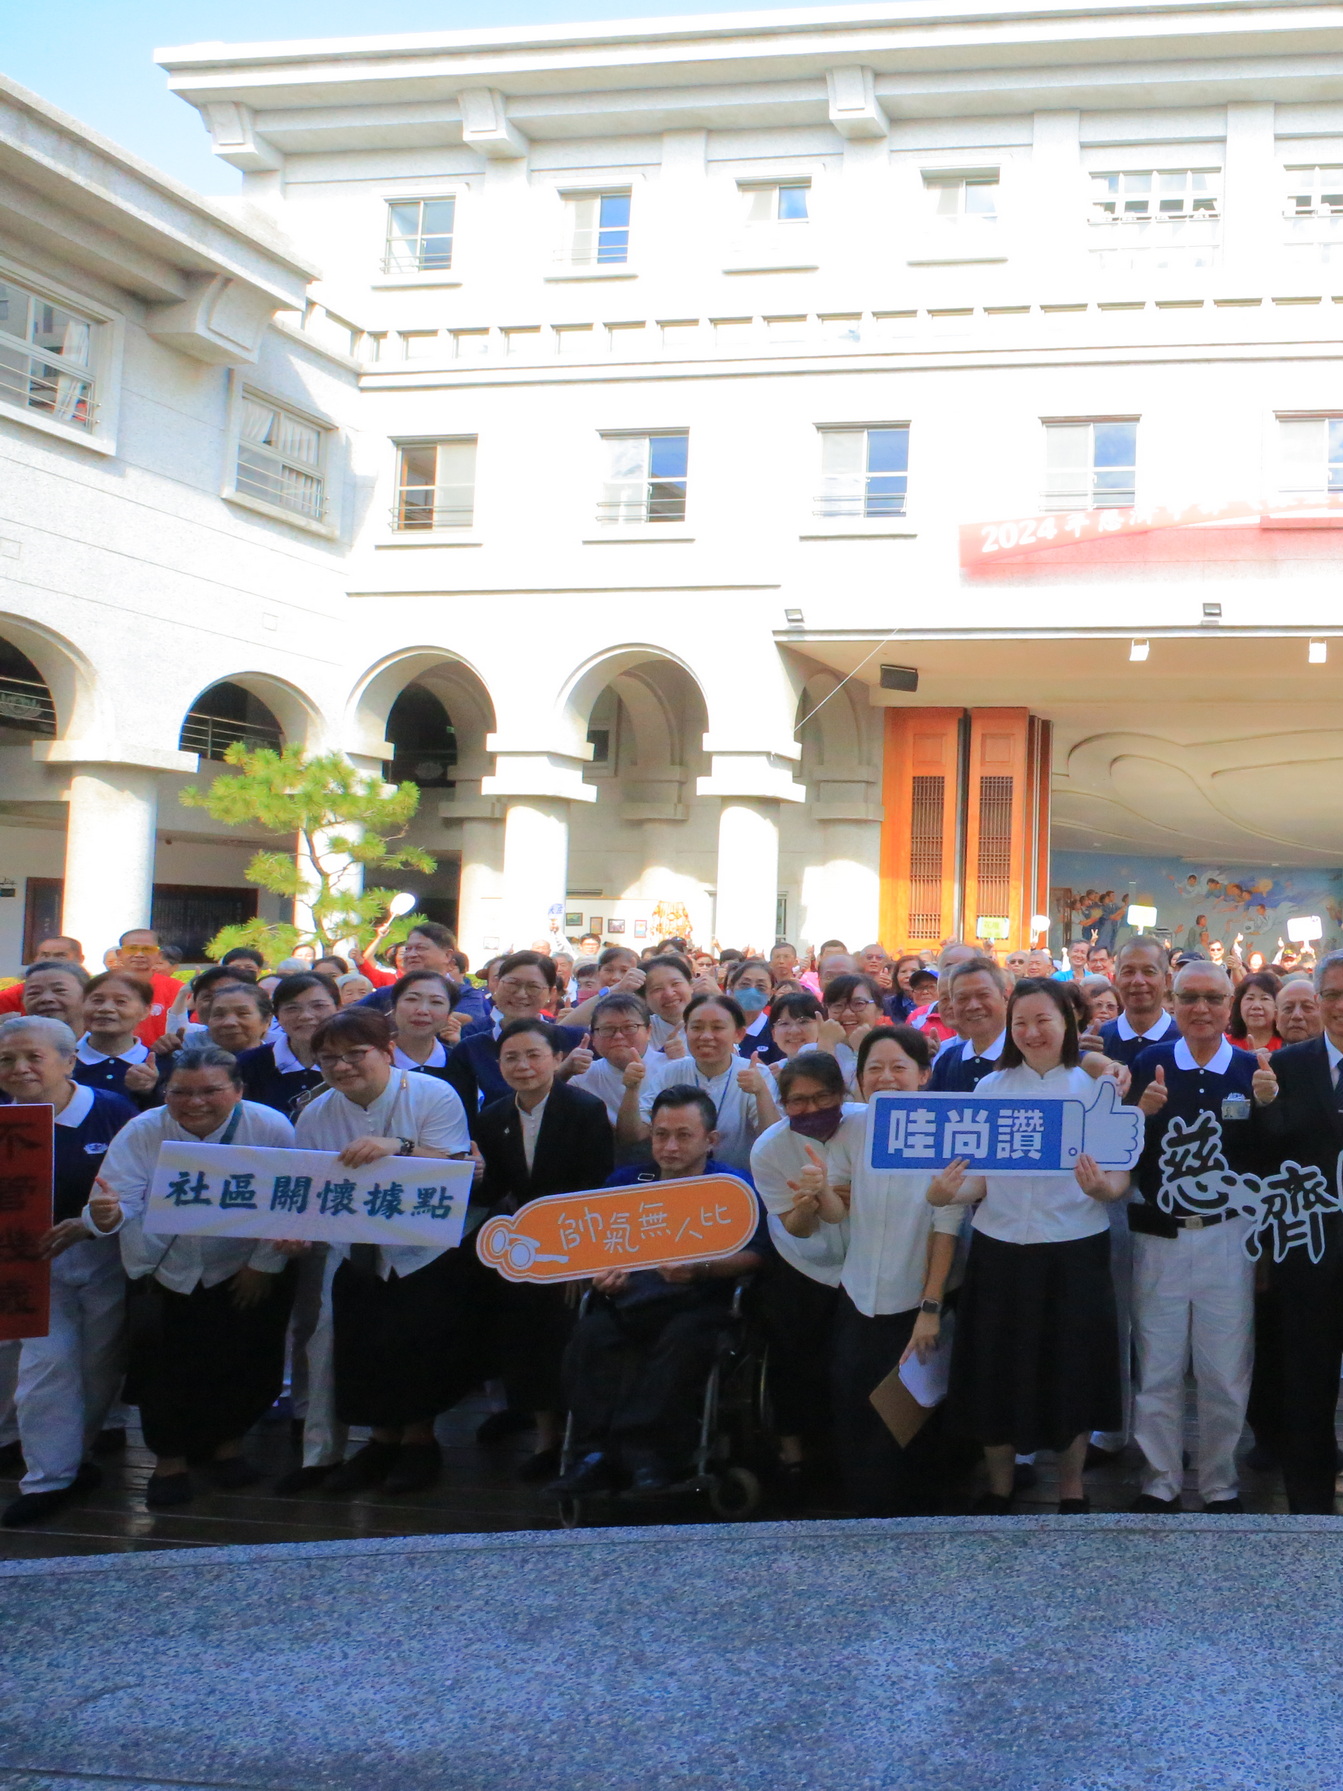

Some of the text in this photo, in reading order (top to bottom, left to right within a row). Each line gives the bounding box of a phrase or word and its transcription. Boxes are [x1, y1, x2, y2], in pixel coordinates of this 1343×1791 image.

[888, 1108, 1045, 1162] 哇尚讚
[166, 1171, 453, 1221] 社區關懷據點
[557, 1202, 732, 1254] 帥氣無人比
